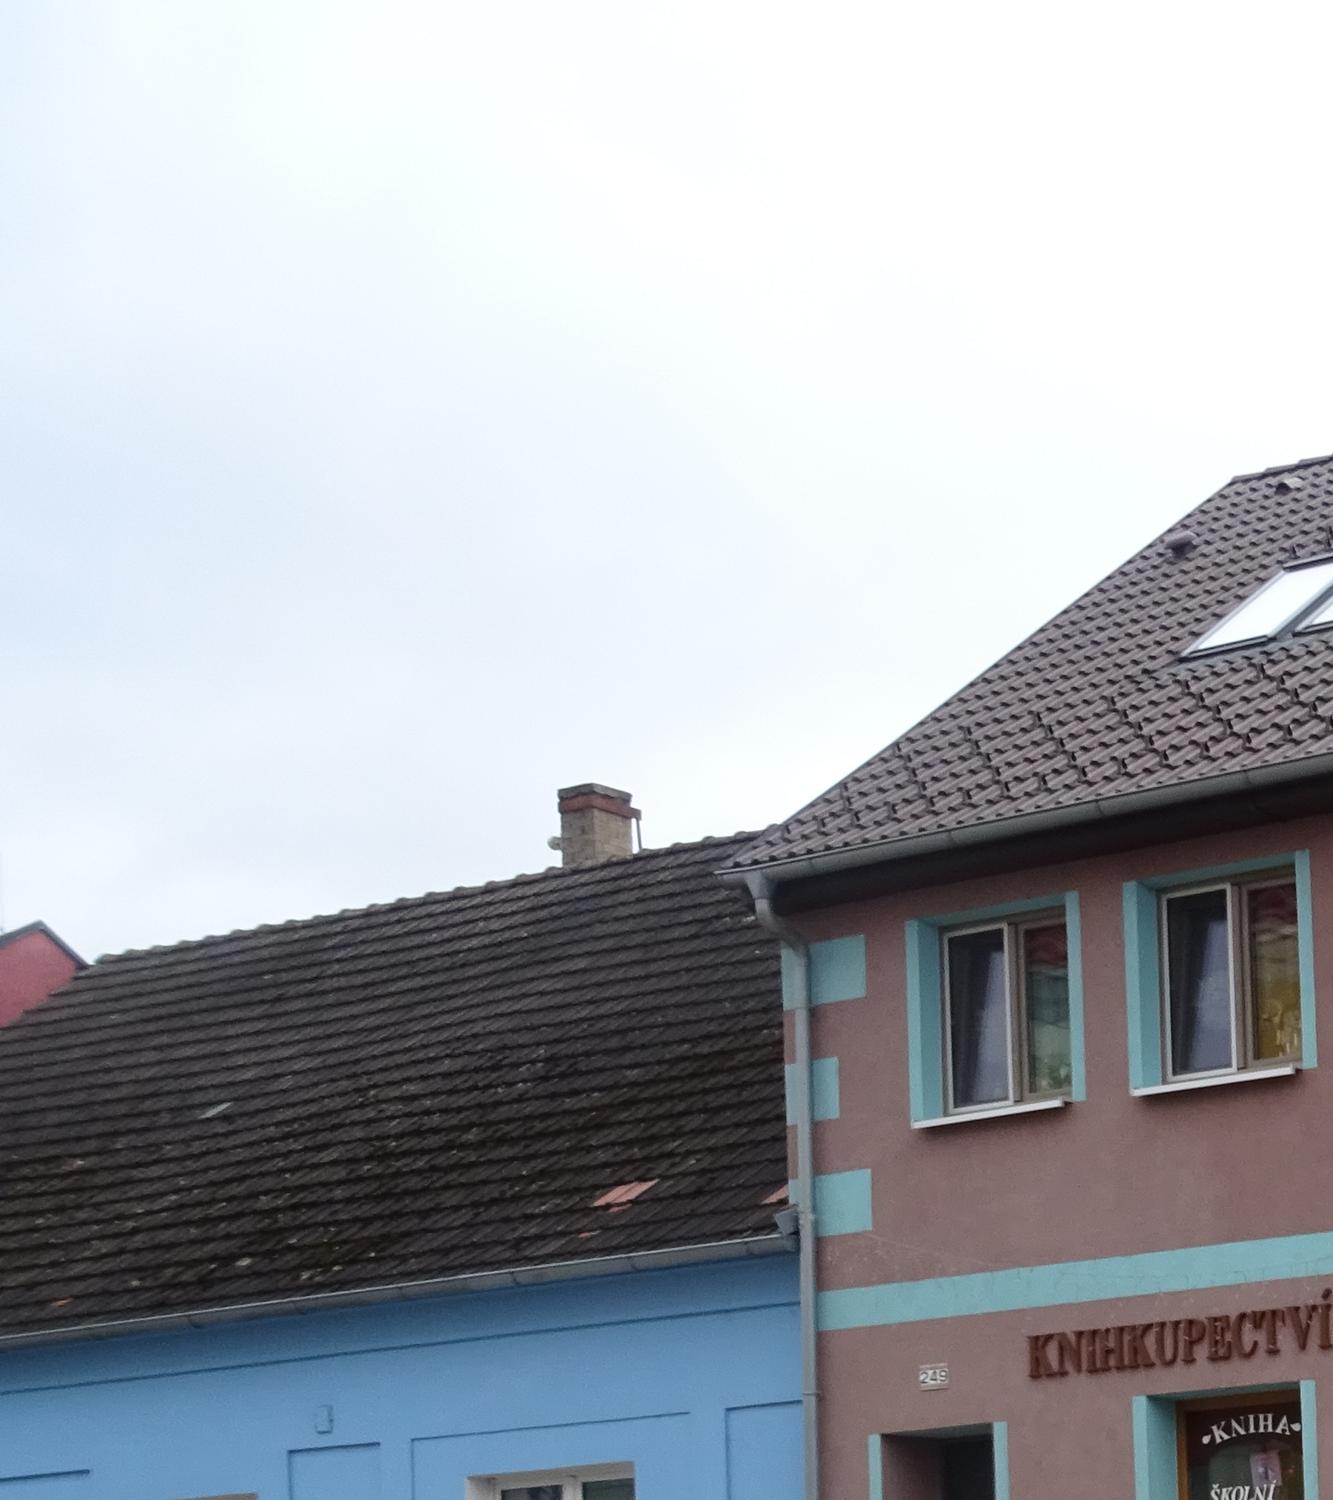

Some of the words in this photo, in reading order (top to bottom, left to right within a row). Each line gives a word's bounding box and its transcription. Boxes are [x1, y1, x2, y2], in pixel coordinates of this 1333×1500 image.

[1027, 1288, 1333, 1379] KNIHKUPECTVÍ
[919, 1369, 948, 1384] 249
[1211, 1413, 1291, 1445] KNIHA
